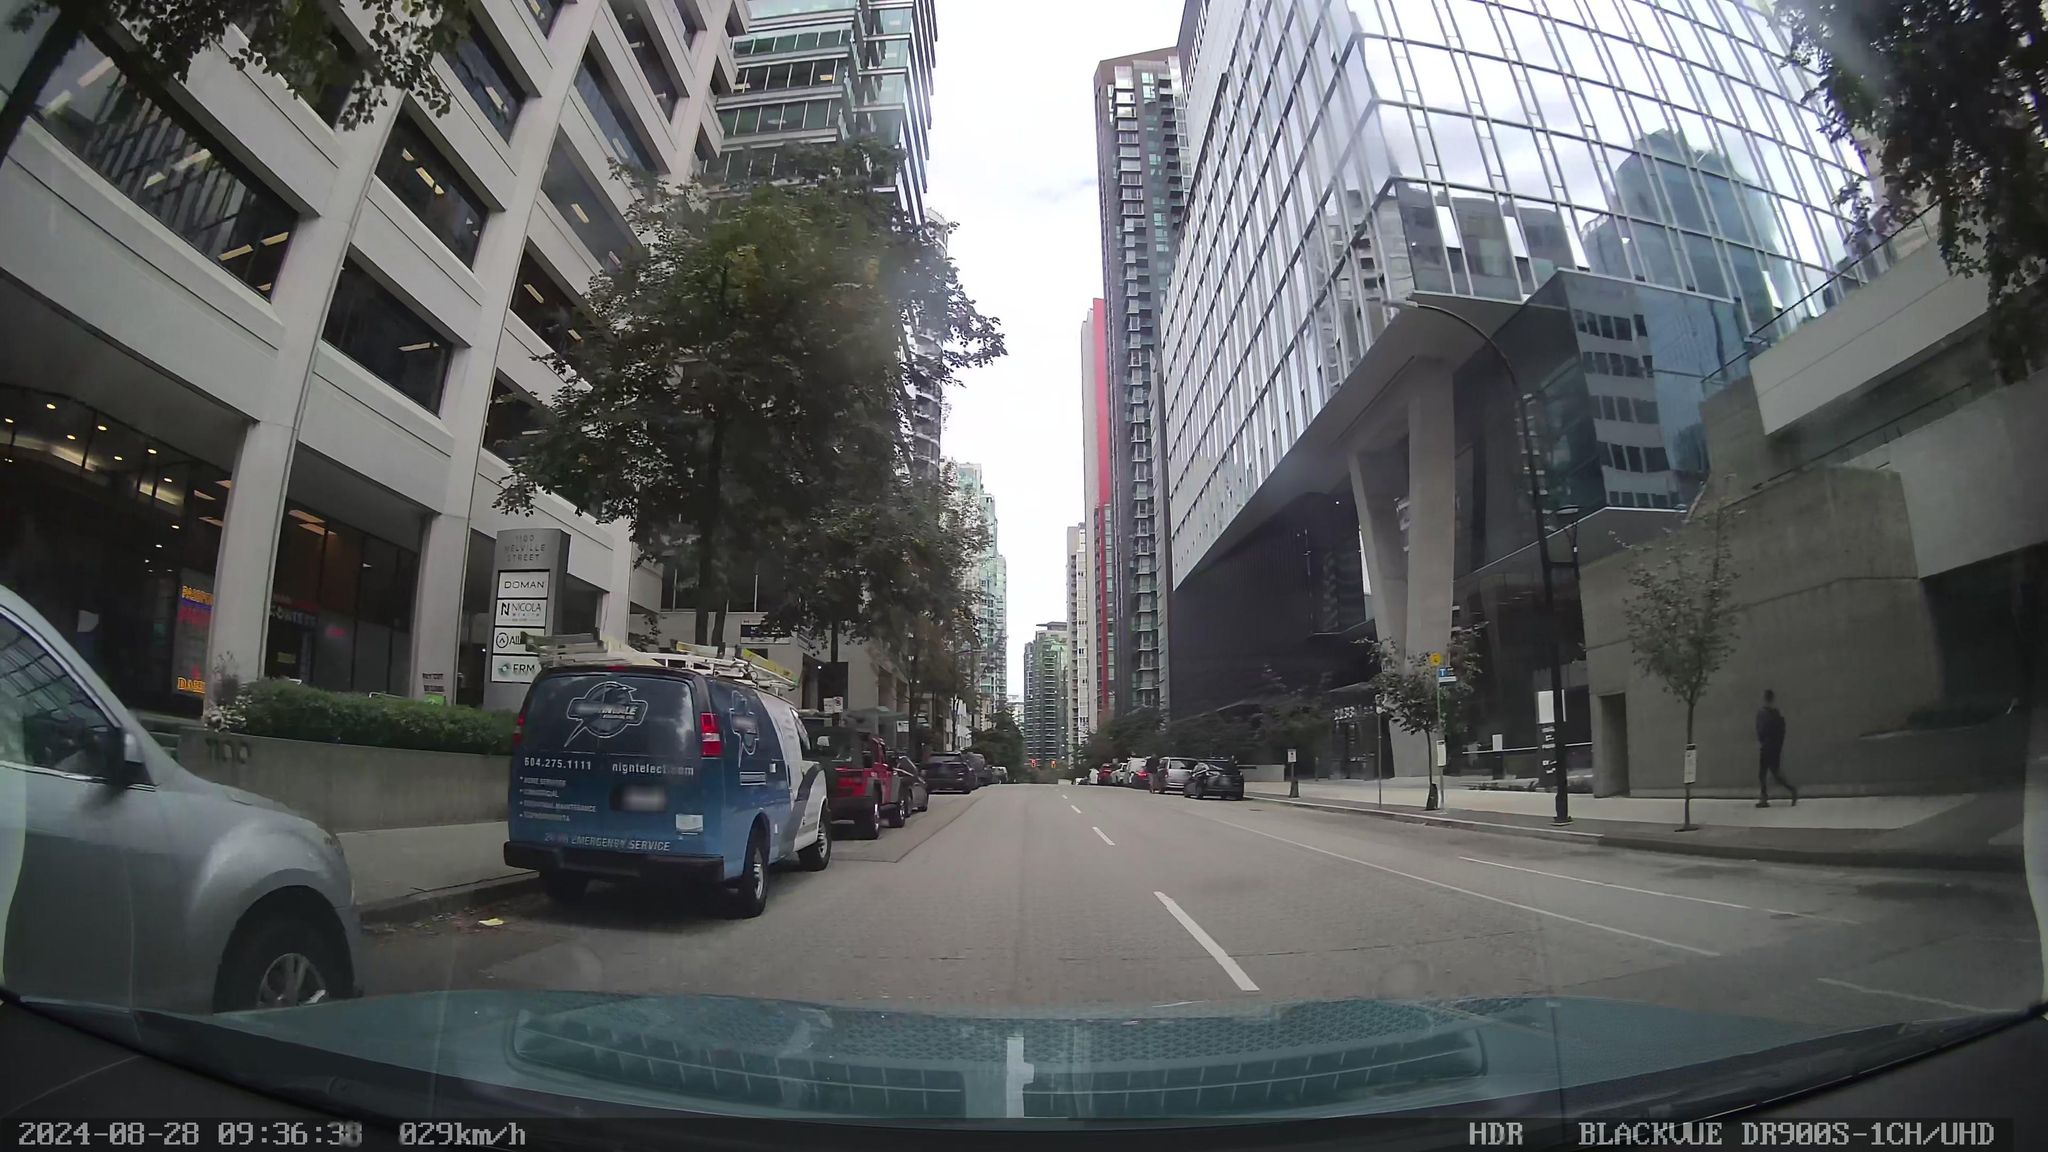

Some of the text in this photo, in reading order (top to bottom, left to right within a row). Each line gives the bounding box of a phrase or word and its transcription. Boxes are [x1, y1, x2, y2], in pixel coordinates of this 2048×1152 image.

[505, 544, 546, 553] MELVILLE
[507, 554, 540, 562] STREET
[512, 602, 541, 612] NICOLA
[509, 635, 520, 645] All
[513, 664, 535, 672] ERM
[524, 757, 694, 776] 604.275.1111 nightelectom
[629, 840, 671, 851] SERVICE
